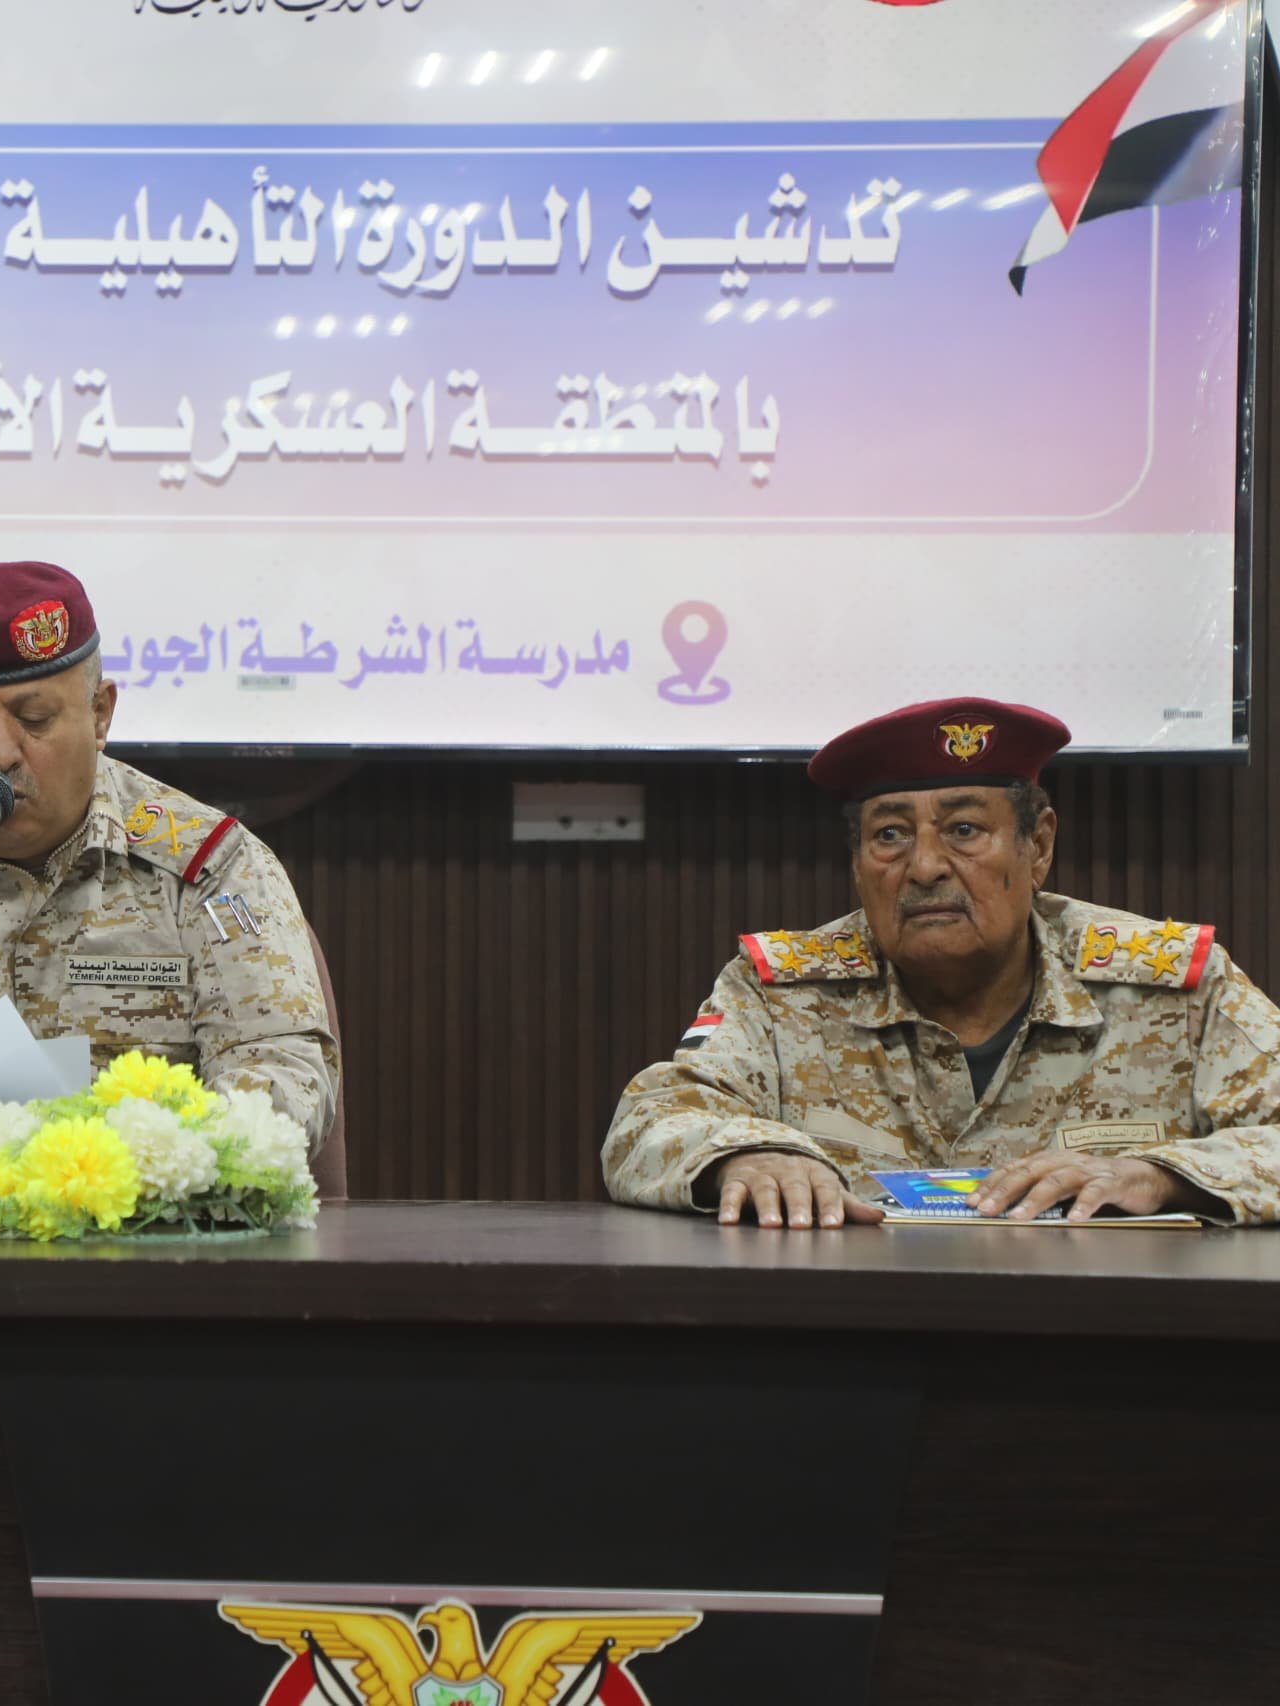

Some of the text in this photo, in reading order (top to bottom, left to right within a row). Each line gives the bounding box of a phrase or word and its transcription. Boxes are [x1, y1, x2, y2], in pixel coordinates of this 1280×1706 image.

[0, 165, 350, 293] التأهيلية
[357, 179, 591, 293] الدورة
[608, 173, 900, 293] تدشين
[73, 367, 435, 484] العسكرية
[447, 368, 780, 484] بالمنطقة
[101, 621, 229, 688] الجوي
[236, 614, 447, 688] الشرطة
[455, 618, 630, 689] مدرسة
[68, 973, 181, 983] YEMENI ARMED FORCES
[69, 959, 181, 974] القوات المسلحة اليمنية
